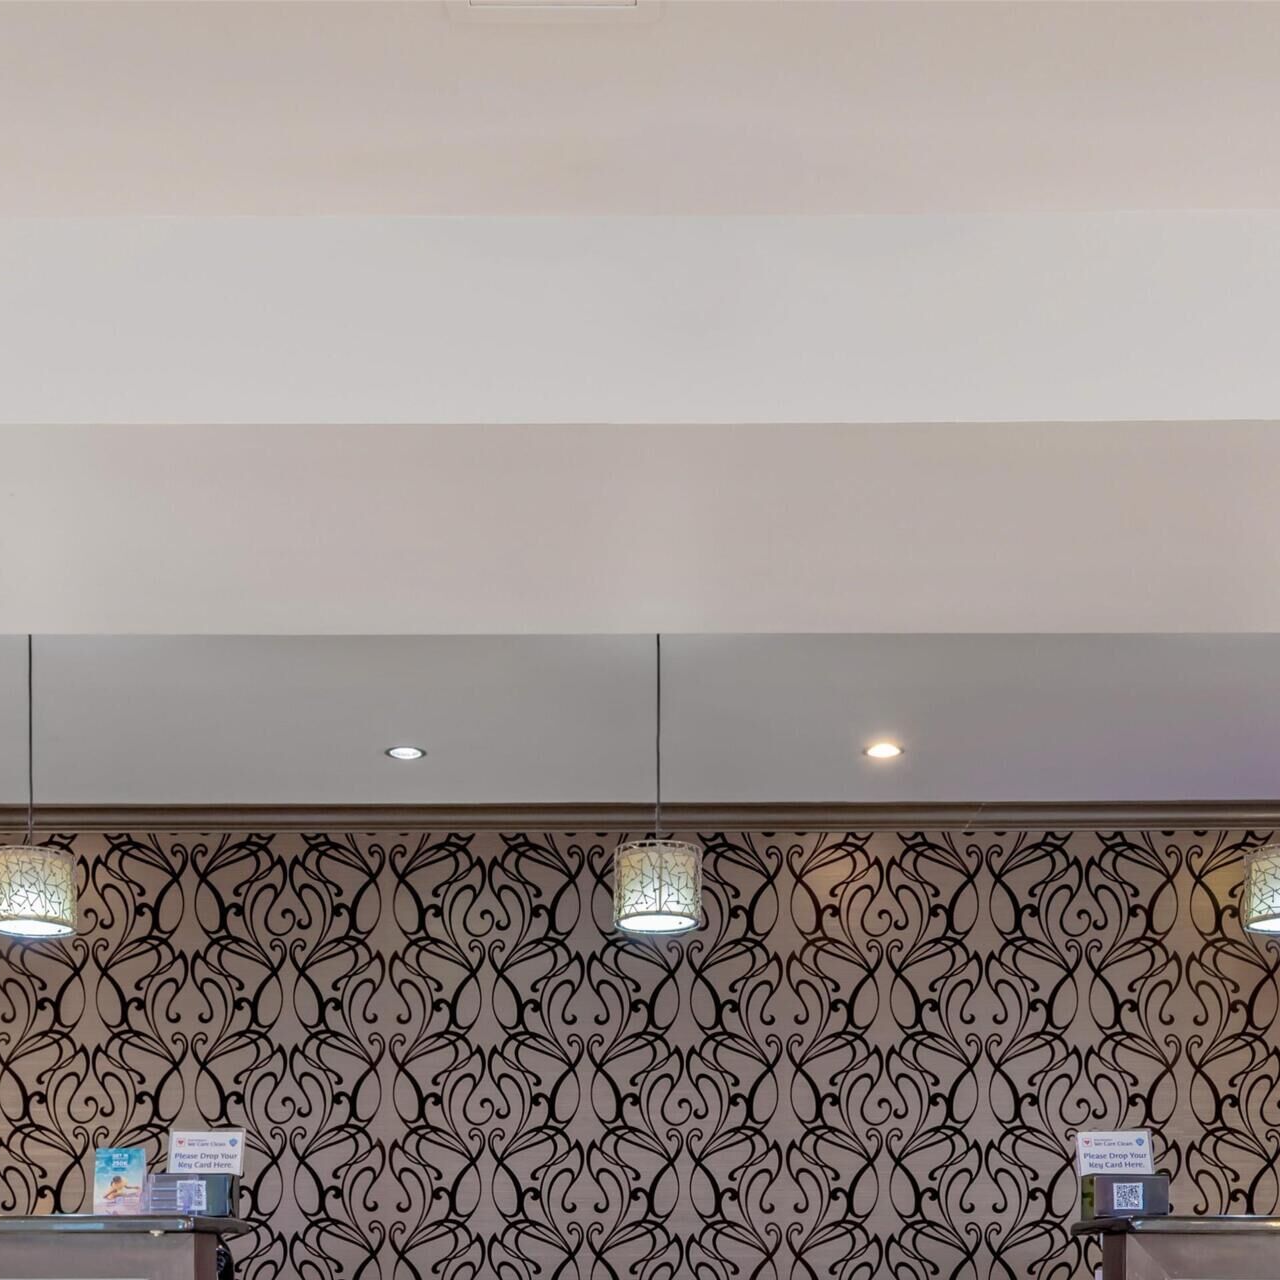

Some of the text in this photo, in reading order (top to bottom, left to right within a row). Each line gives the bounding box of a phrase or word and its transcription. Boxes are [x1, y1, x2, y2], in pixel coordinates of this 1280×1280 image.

[174, 1152, 238, 1161] Please Drop Your
[1083, 1152, 1107, 1160] Please
[1108, 1152, 1128, 1160] Drop
[177, 1161, 193, 1169] Key
[1088, 1161, 1104, 1170] Key
